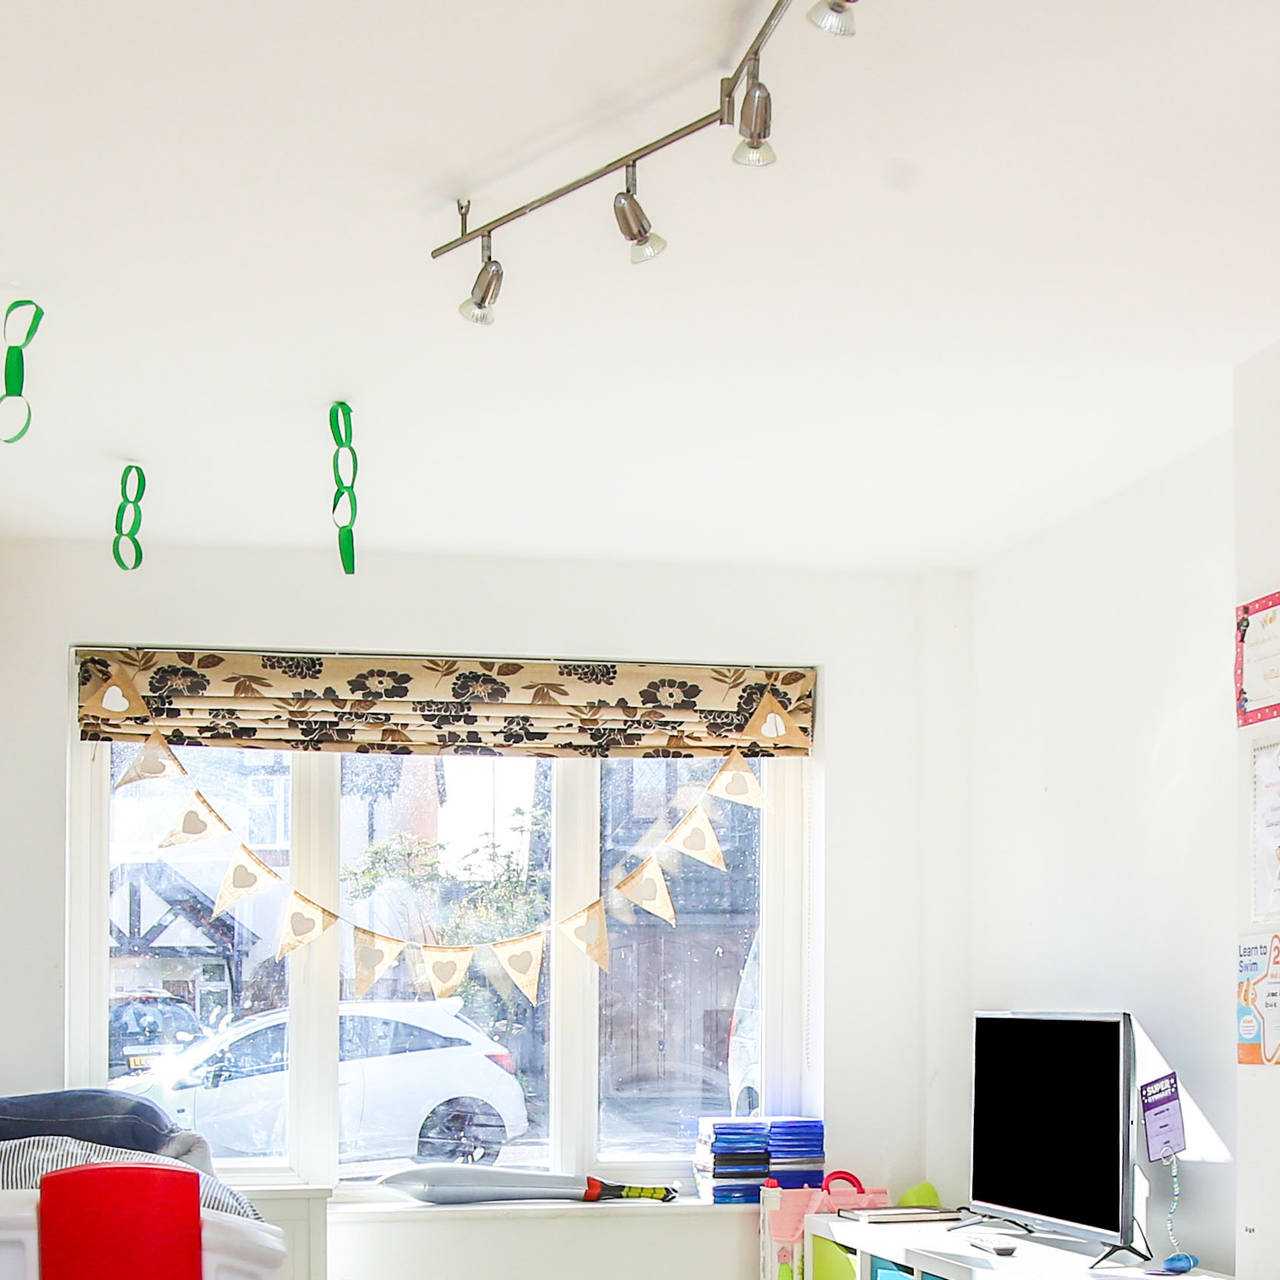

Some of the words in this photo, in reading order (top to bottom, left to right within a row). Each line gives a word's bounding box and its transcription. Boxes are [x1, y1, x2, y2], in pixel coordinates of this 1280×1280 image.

[1239, 945, 1259, 957] Learn
[1273, 946, 1280, 965] 2
[1239, 960, 1258, 973] Swim
[1147, 1079, 1170, 1096] SUPER
